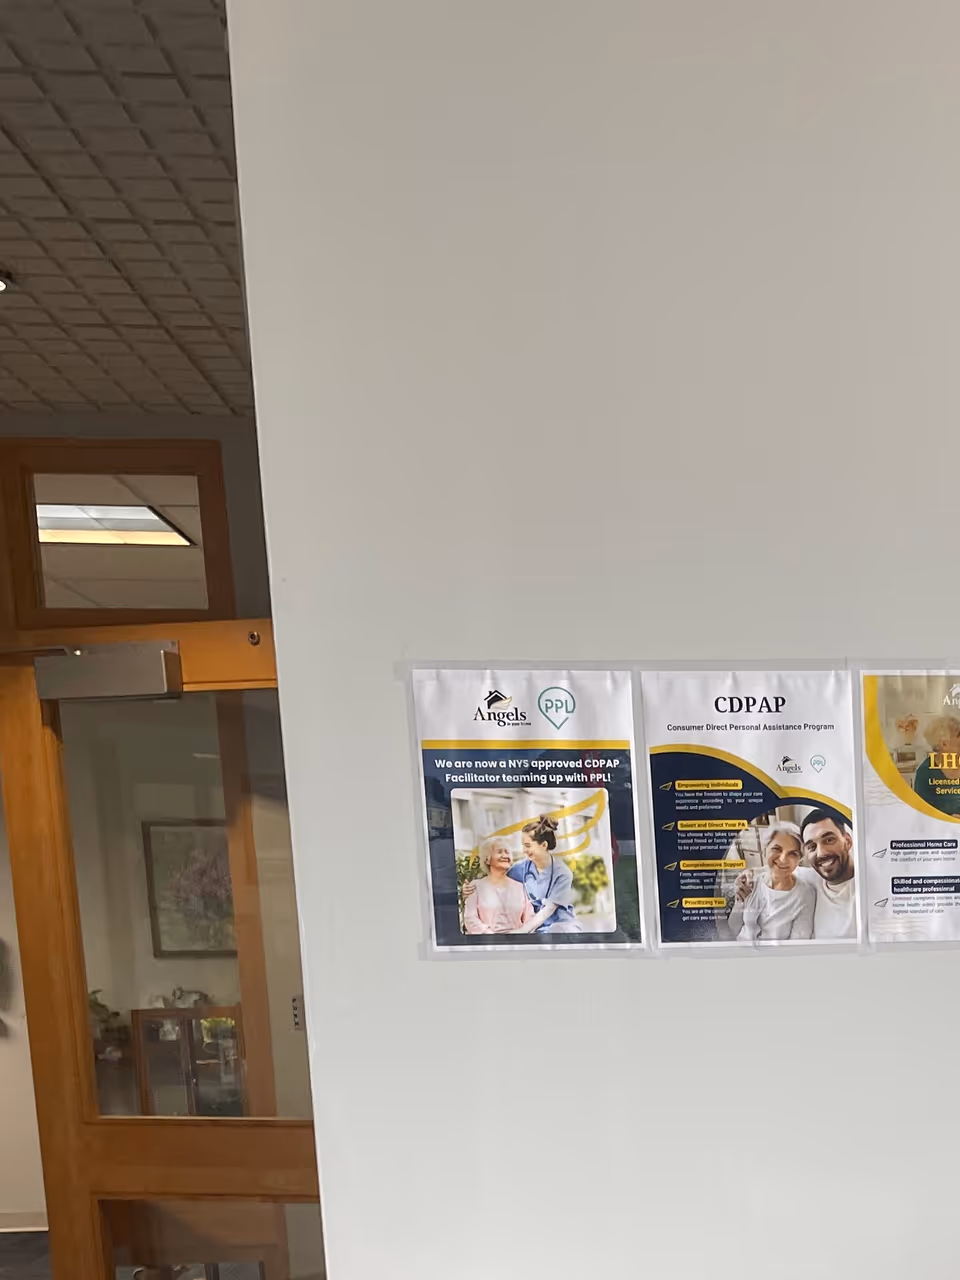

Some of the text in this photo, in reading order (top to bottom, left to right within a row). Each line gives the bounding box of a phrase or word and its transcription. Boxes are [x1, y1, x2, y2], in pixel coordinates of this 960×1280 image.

[544, 699, 576, 714] PPL
[714, 696, 786, 714] CDPAP
[473, 706, 527, 727] Angels
[666, 724, 834, 732] Consumer Direct Personal Assistance Program
[434, 759, 452, 768] We
[508, 759, 529, 768] NYS
[531, 759, 582, 770] approved
[584, 759, 620, 768] CDPAP
[776, 764, 802, 774] Angels
[446, 773, 612, 784] Facilitator teaming up with PPL!
